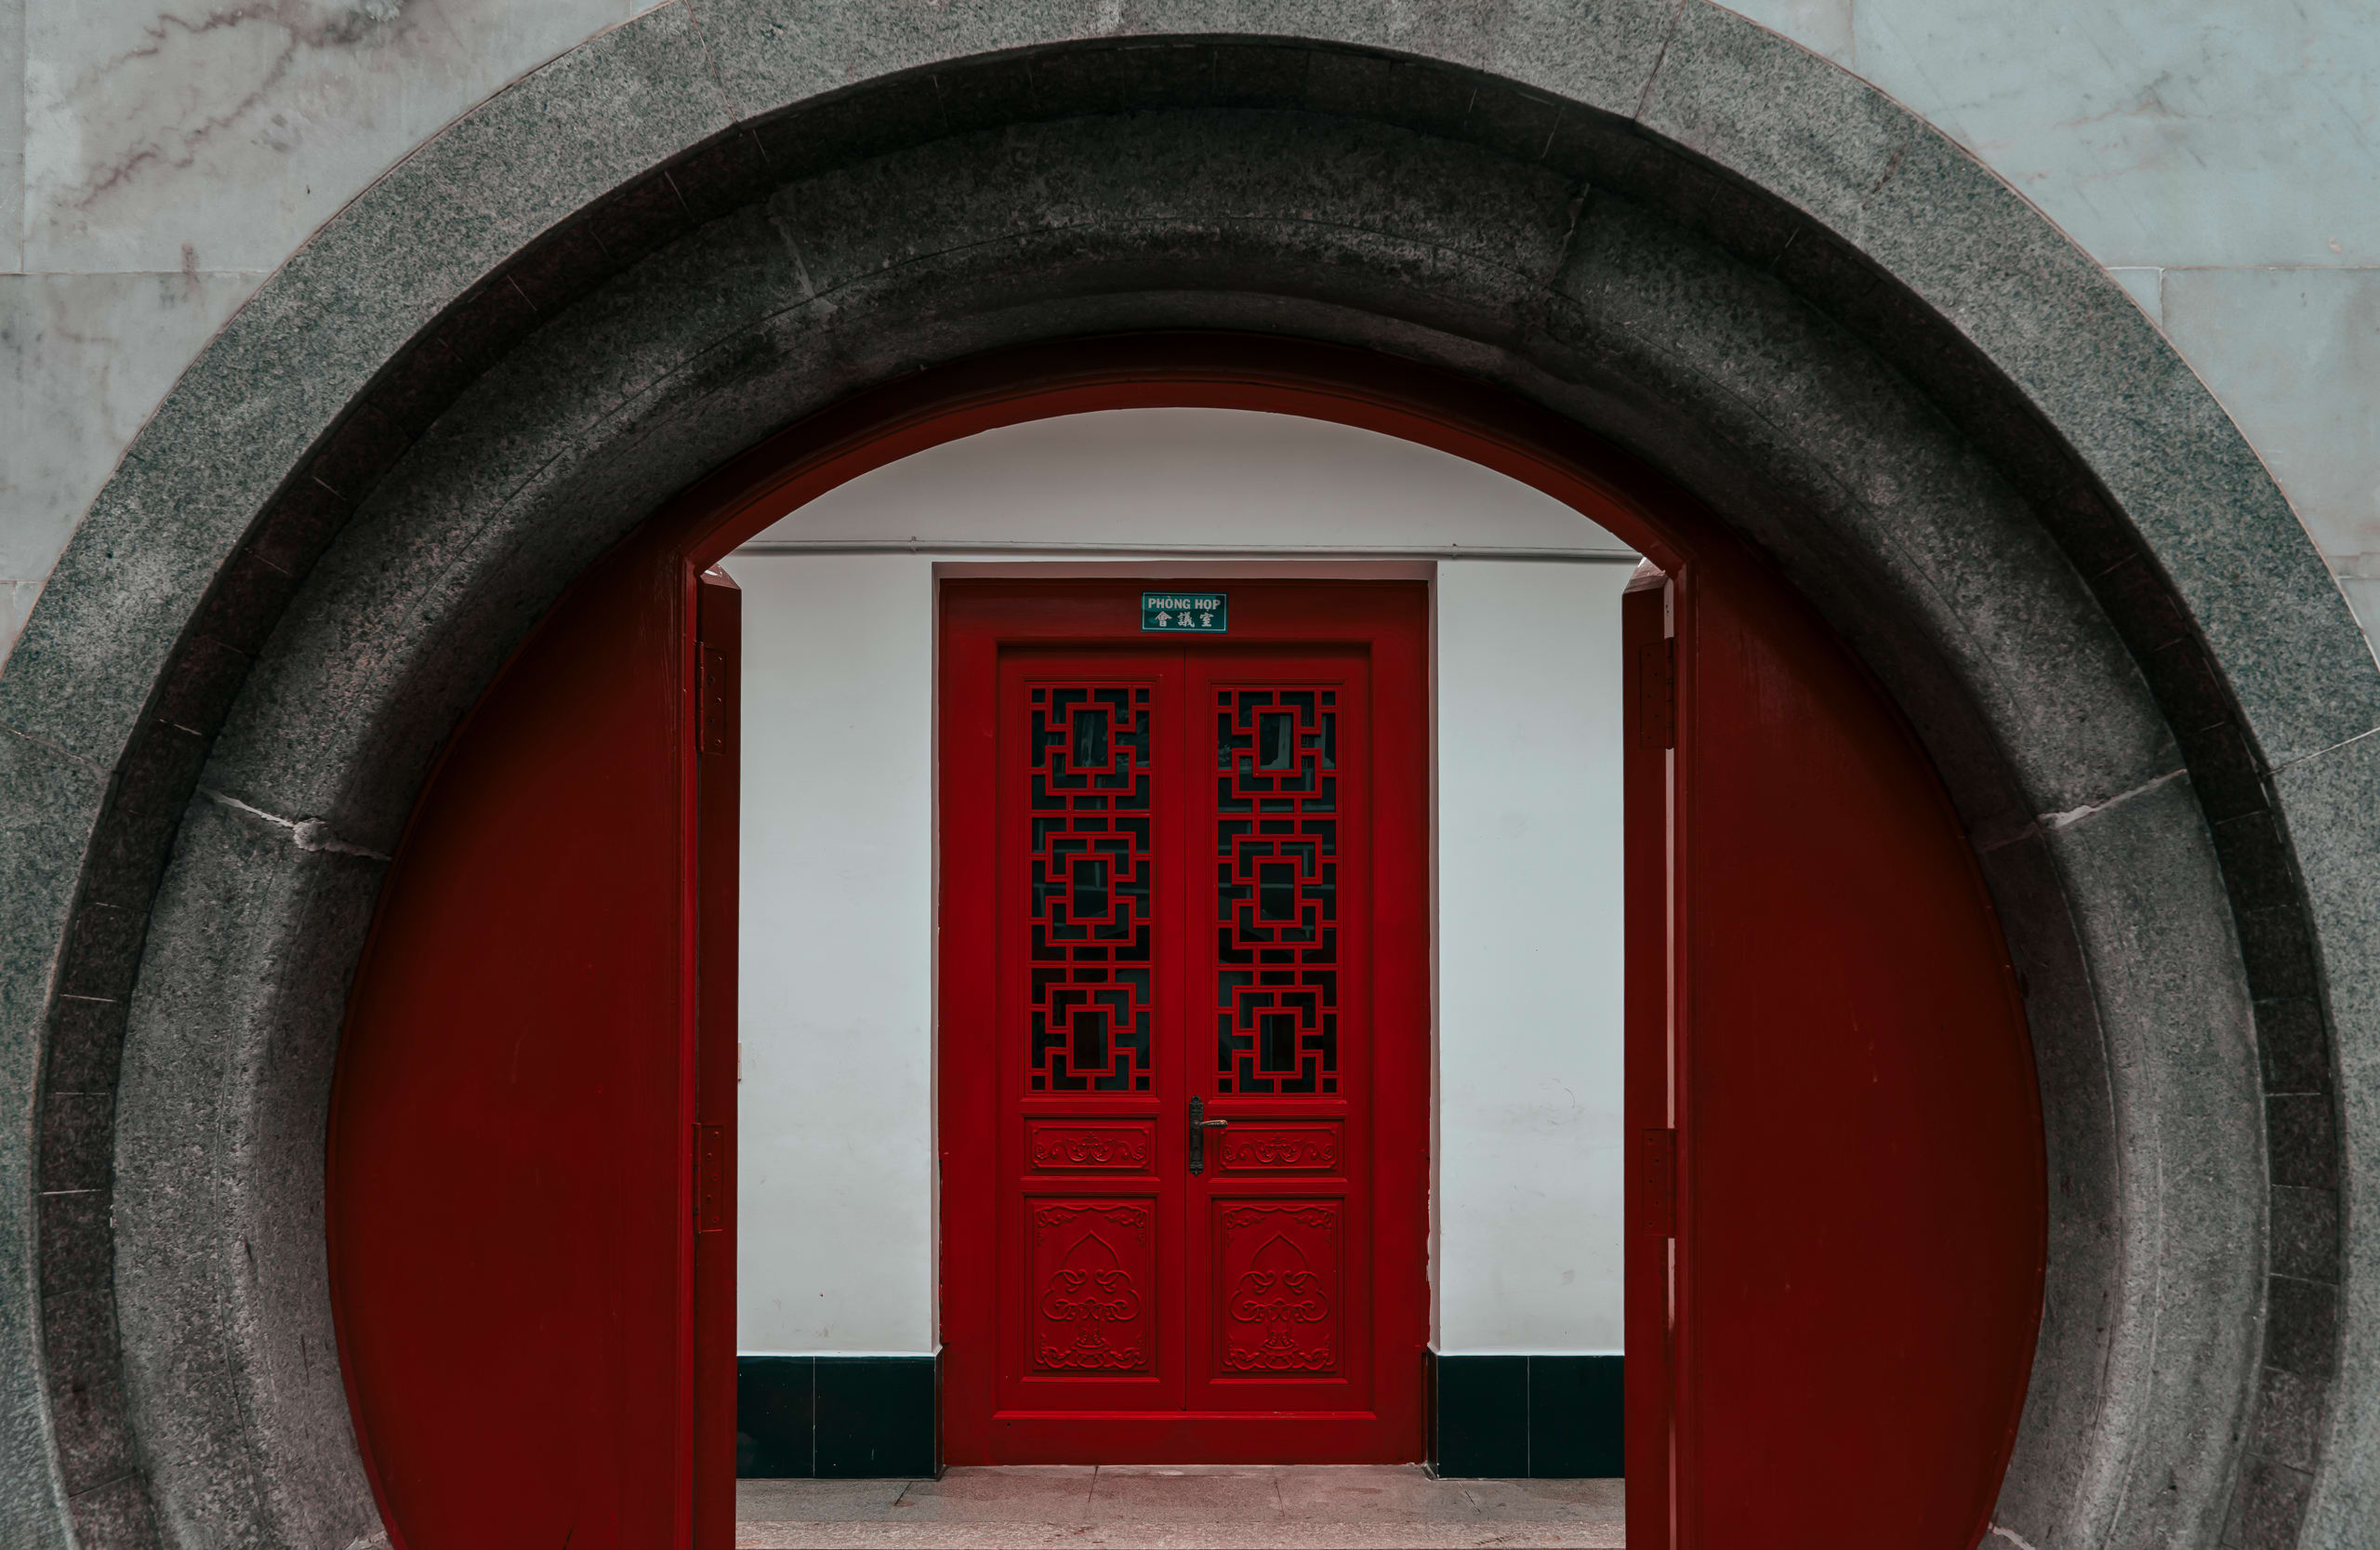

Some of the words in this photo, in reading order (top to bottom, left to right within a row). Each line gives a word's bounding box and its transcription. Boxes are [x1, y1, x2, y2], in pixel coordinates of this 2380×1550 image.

[1148, 596, 1190, 609] PHÒNG
[1195, 599, 1221, 612] HỌP
[1155, 611, 1214, 628] 會議室
